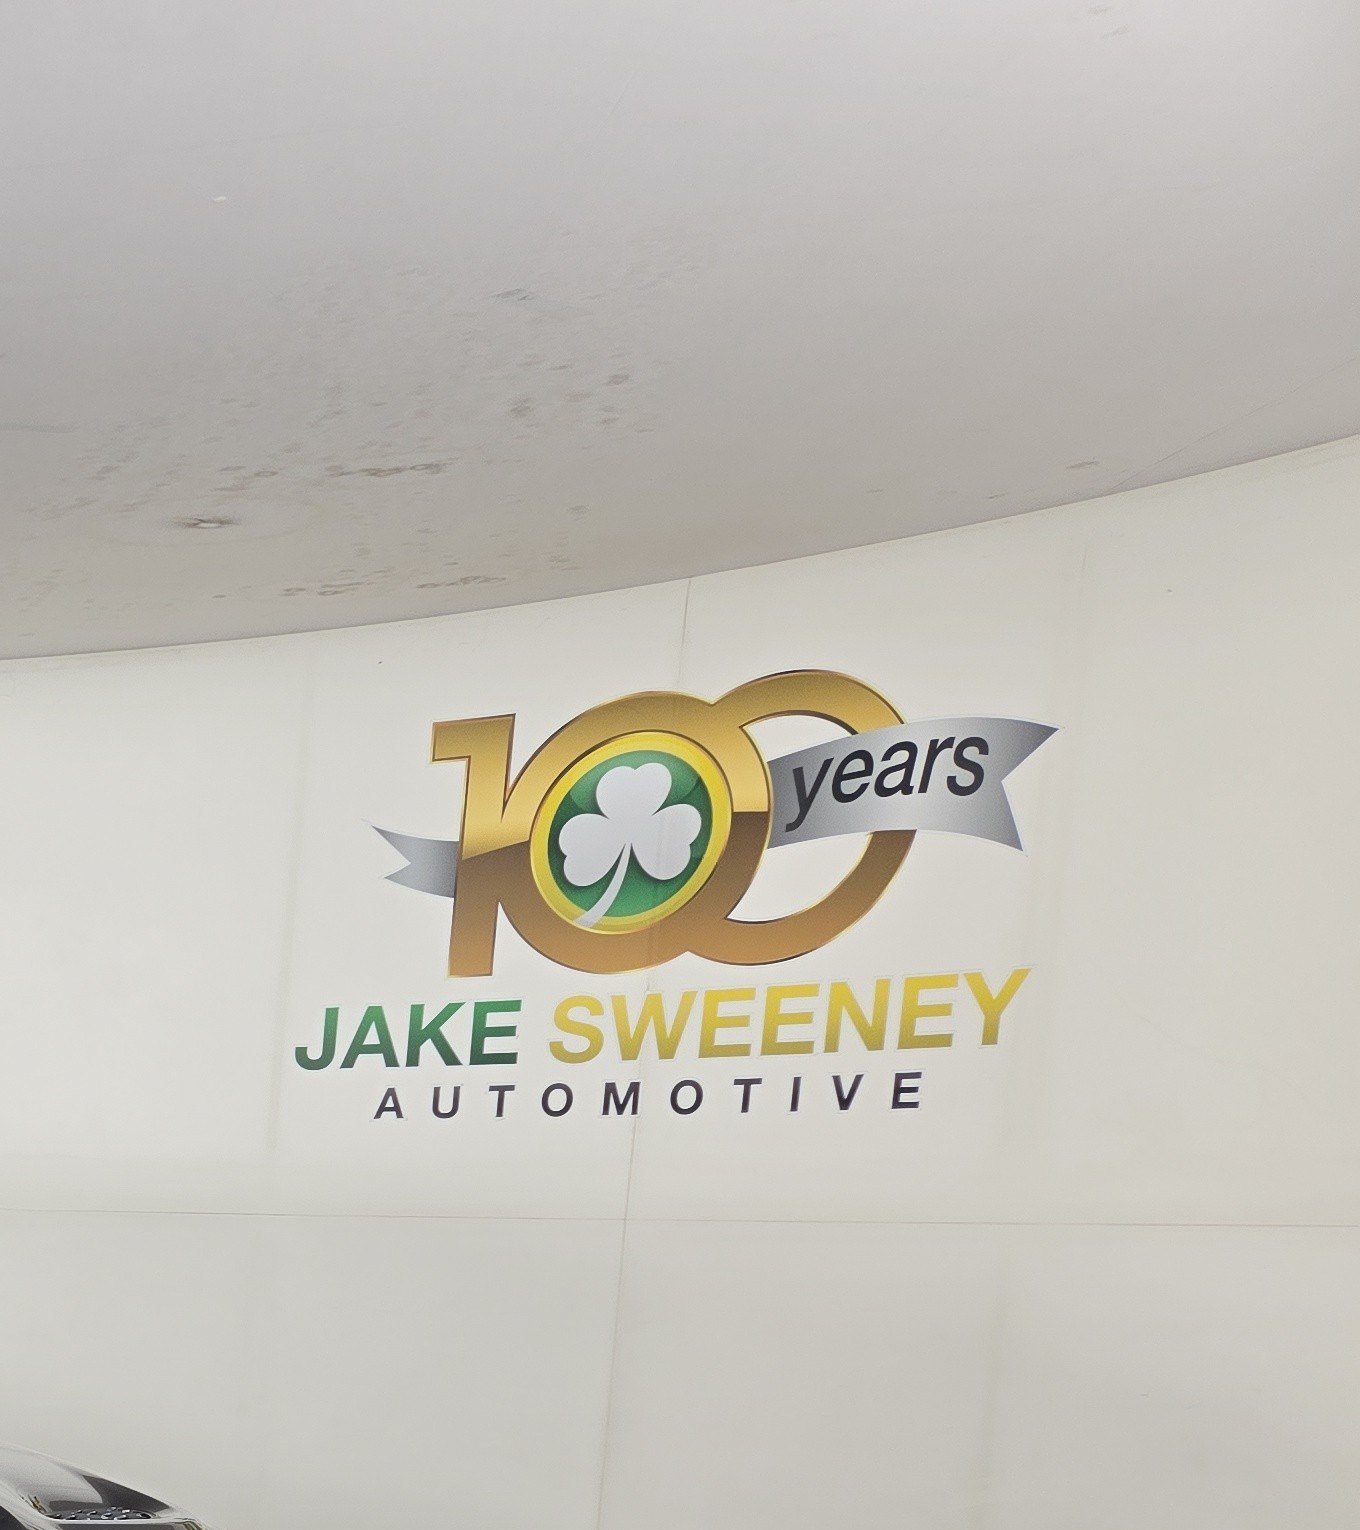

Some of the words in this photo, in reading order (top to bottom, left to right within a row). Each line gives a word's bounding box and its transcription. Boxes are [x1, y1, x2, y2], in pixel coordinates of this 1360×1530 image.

[785, 732, 989, 833] years
[294, 1000, 522, 1071] JAKE
[549, 968, 1032, 1064] SWEENEY
[373, 1072, 924, 1121] AUTOMOTIVE
